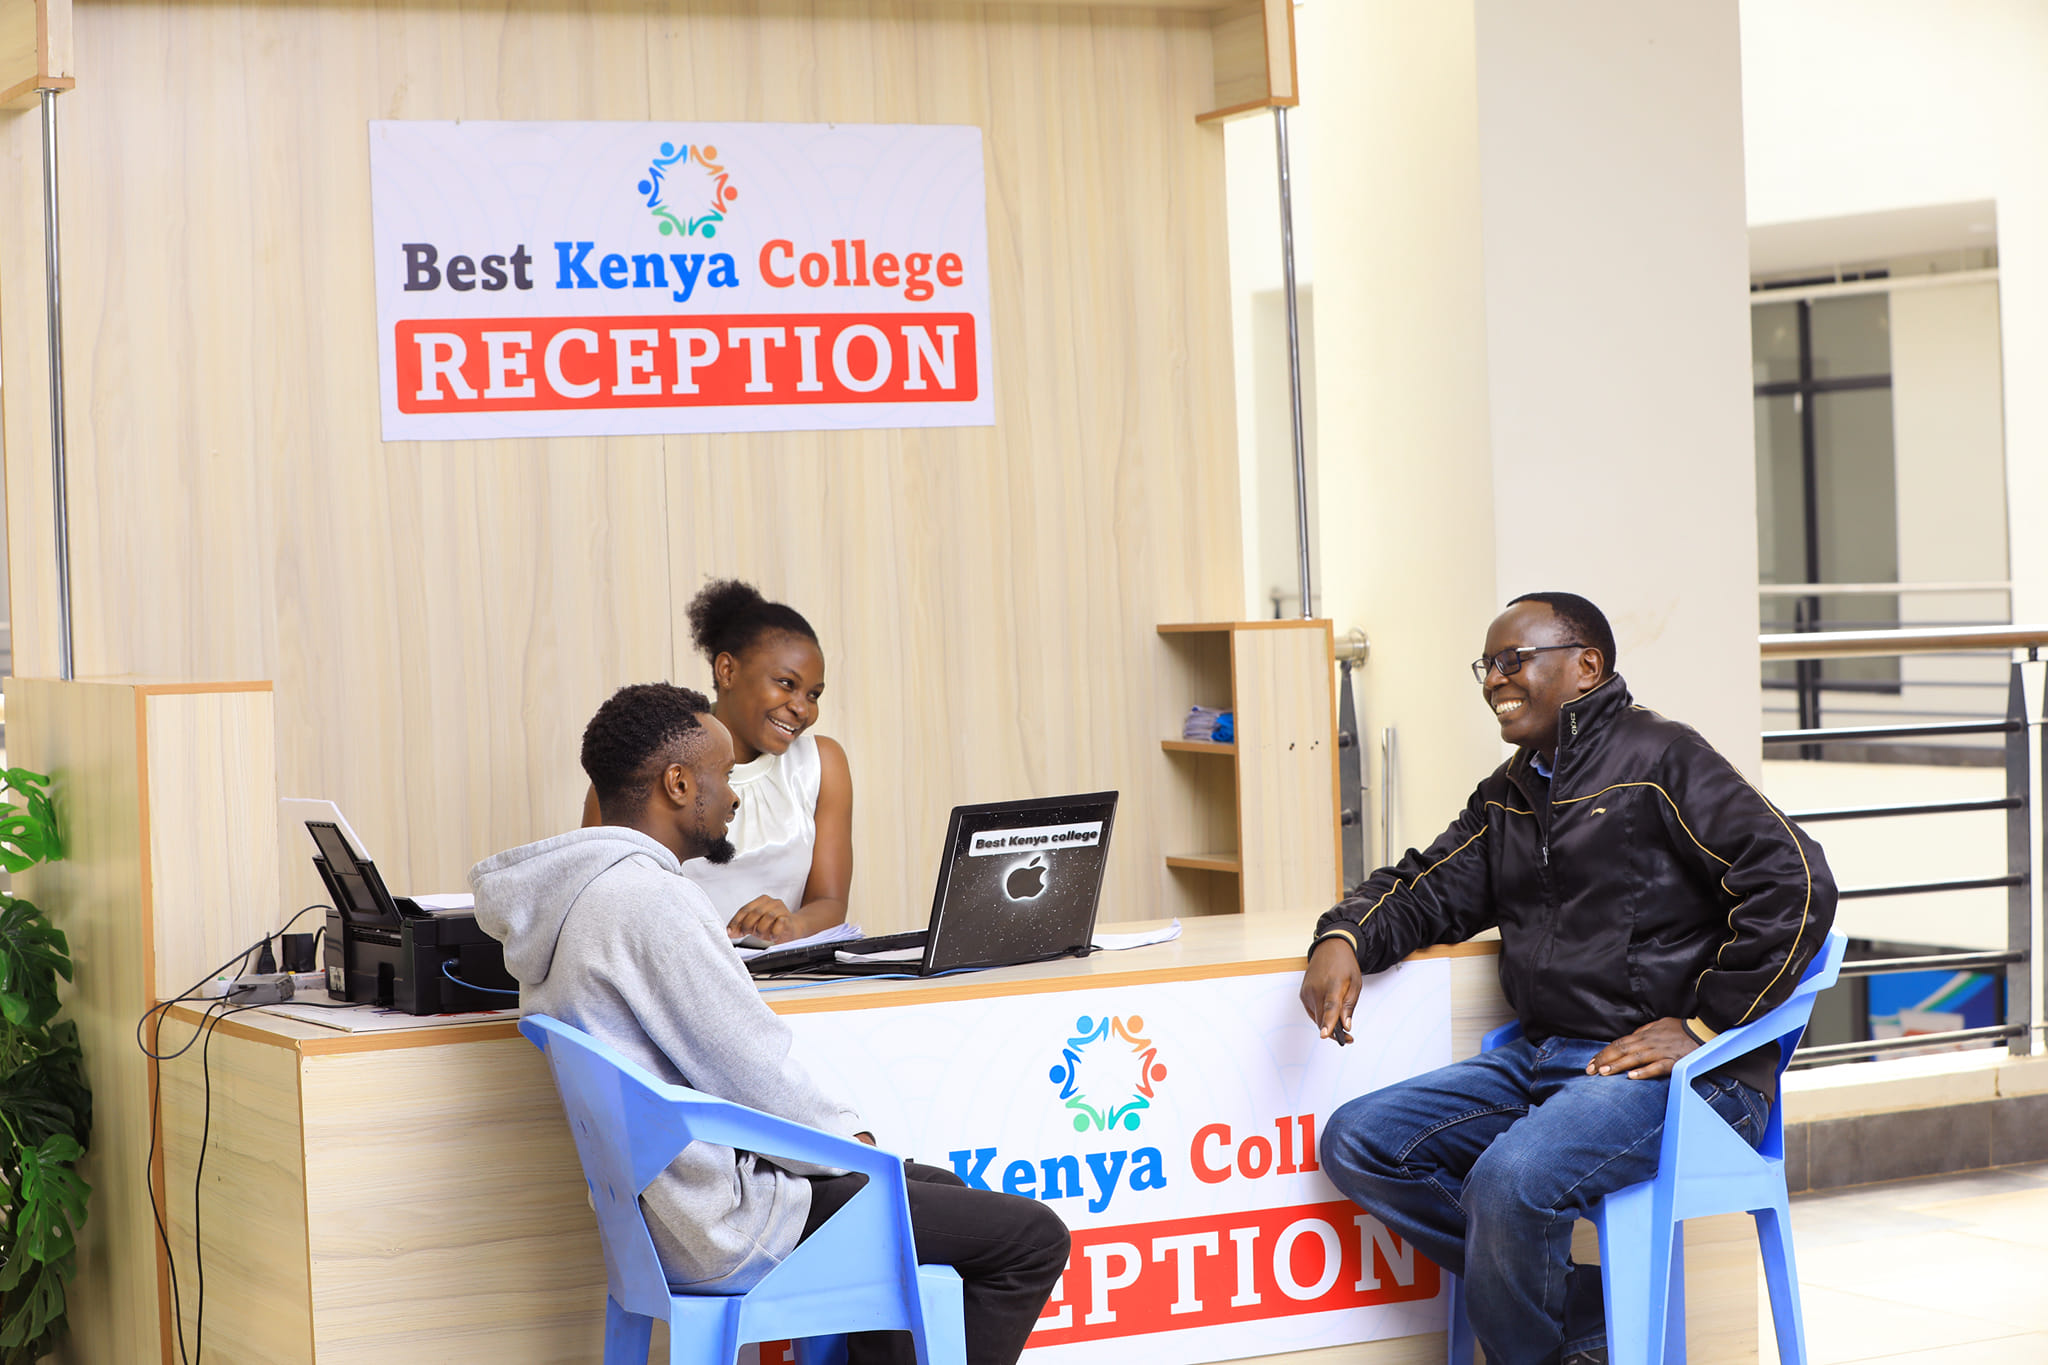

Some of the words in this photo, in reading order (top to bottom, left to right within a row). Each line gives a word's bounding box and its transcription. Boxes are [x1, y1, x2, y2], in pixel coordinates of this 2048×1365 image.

[403, 244, 533, 291] Best
[554, 241, 739, 303] Kenya
[759, 239, 963, 302] College
[413, 324, 960, 401] RECEPTION
[975, 837, 1006, 850] Best
[1008, 835, 1049, 847] Kenya
[1051, 829, 1098, 844] college
[949, 1147, 1167, 1214] Kenya
[1190, 1114, 1320, 1184] Coll
